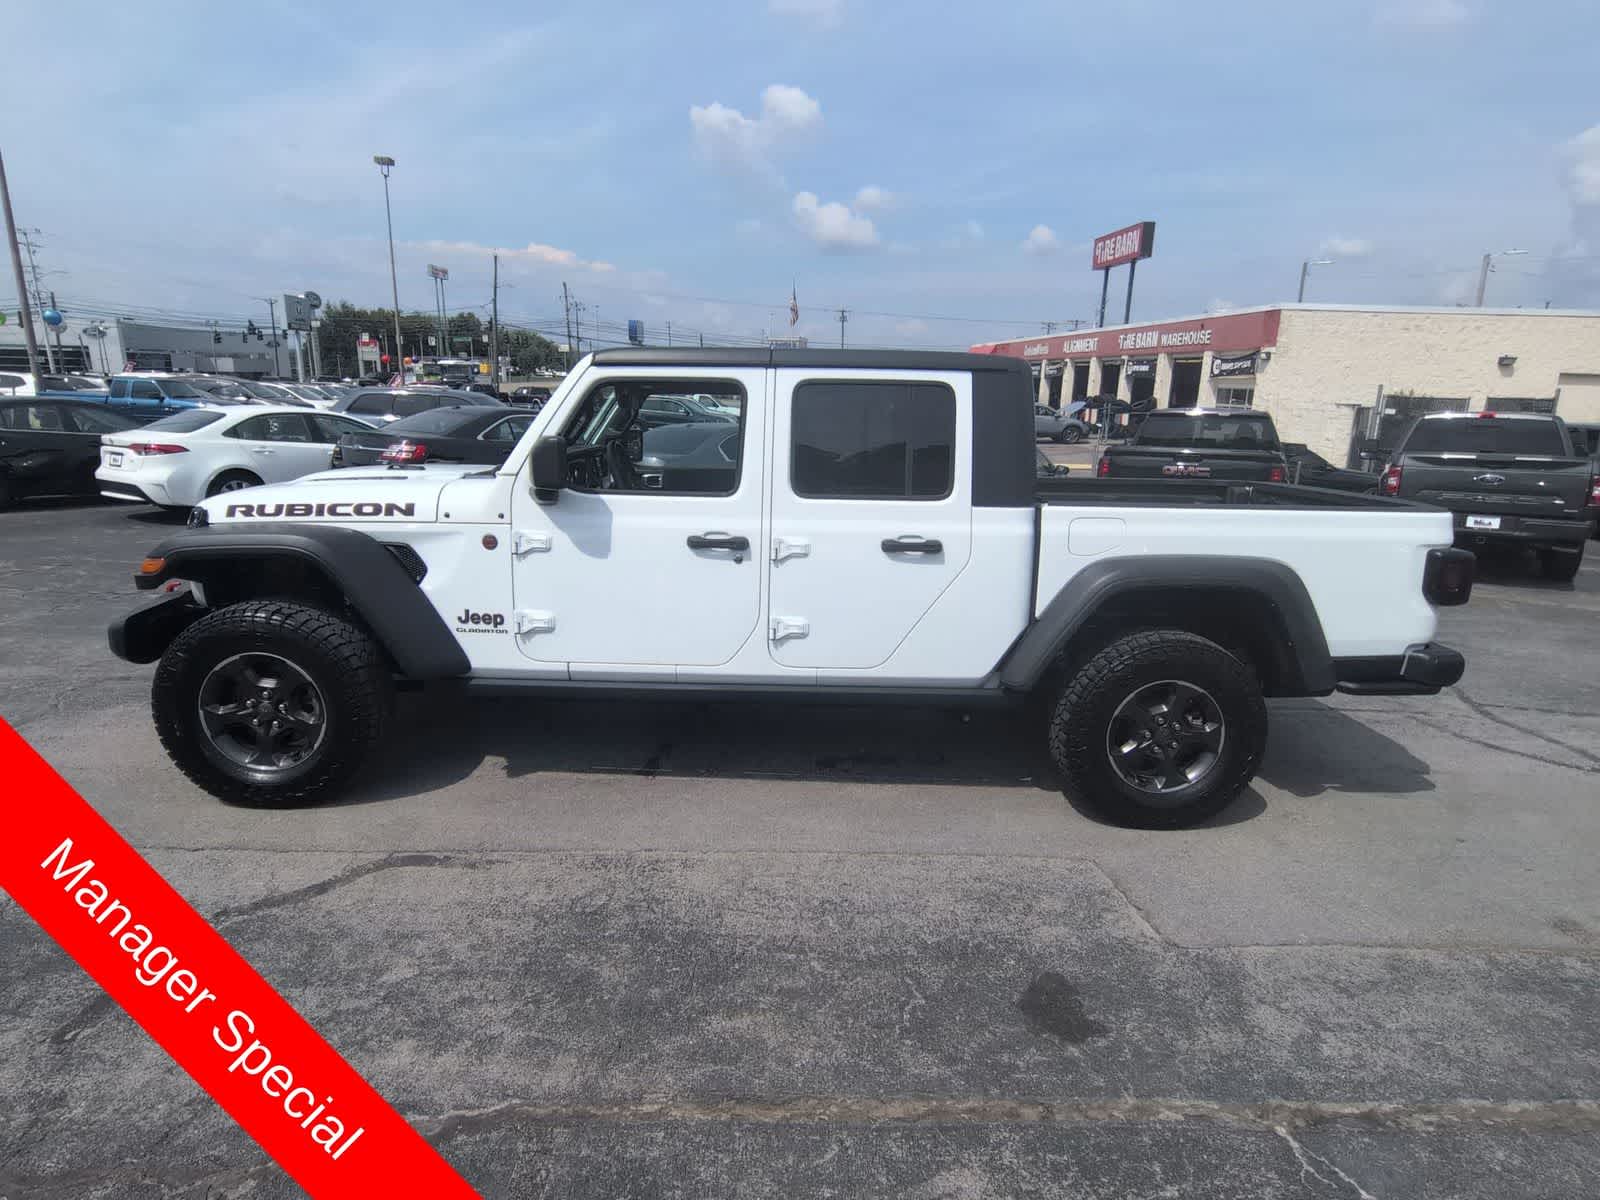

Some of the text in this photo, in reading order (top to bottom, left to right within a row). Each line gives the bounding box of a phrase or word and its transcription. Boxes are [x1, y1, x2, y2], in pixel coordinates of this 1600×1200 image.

[1115, 230, 1140, 258] BARN
[1063, 338, 1098, 353] ALIGNMENT
[1135, 330, 1158, 349] BARN
[1160, 329, 1212, 347] WAREHOUSE
[225, 502, 415, 518] RUBICON
[457, 608, 504, 628] Jeep
